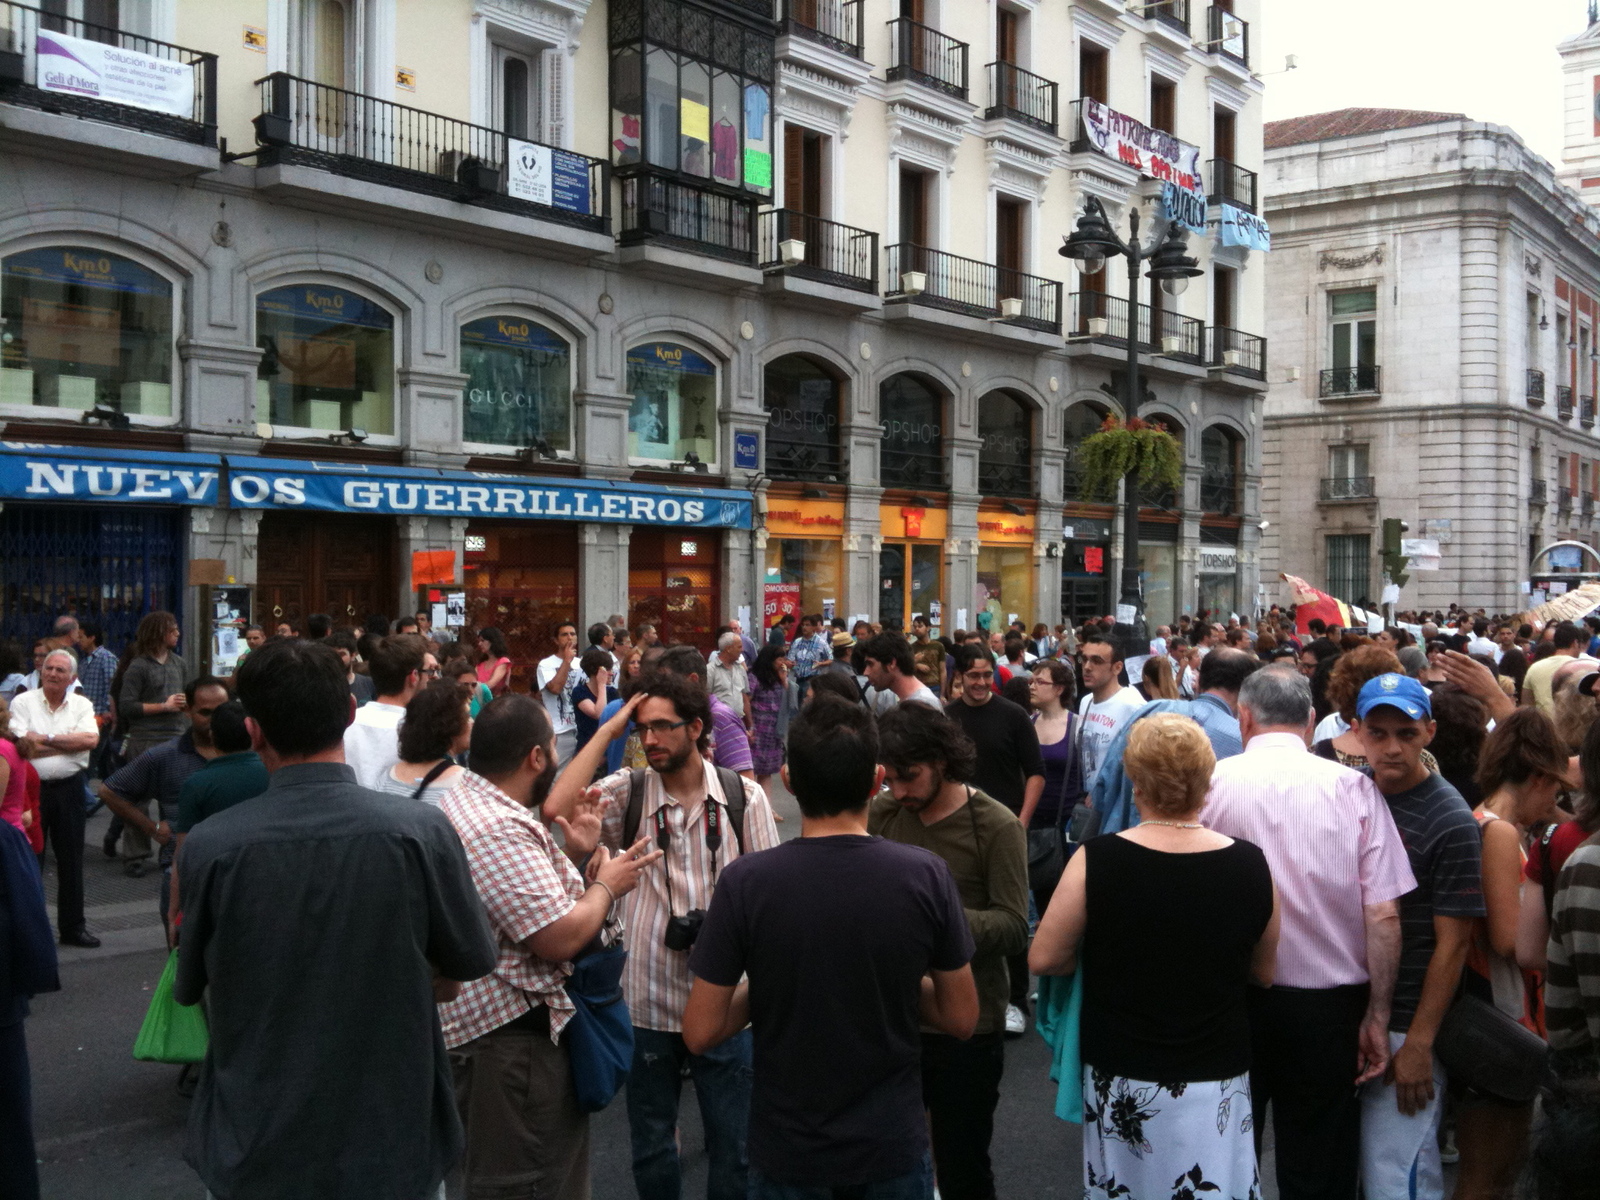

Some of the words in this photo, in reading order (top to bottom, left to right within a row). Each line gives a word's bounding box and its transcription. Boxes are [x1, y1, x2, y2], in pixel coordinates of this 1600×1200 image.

[103, 50, 146, 68] Solución
[148, 60, 157, 71] al
[469, 388, 532, 409] GUCCI
[343, 480, 705, 523] GUERRILLEROS
